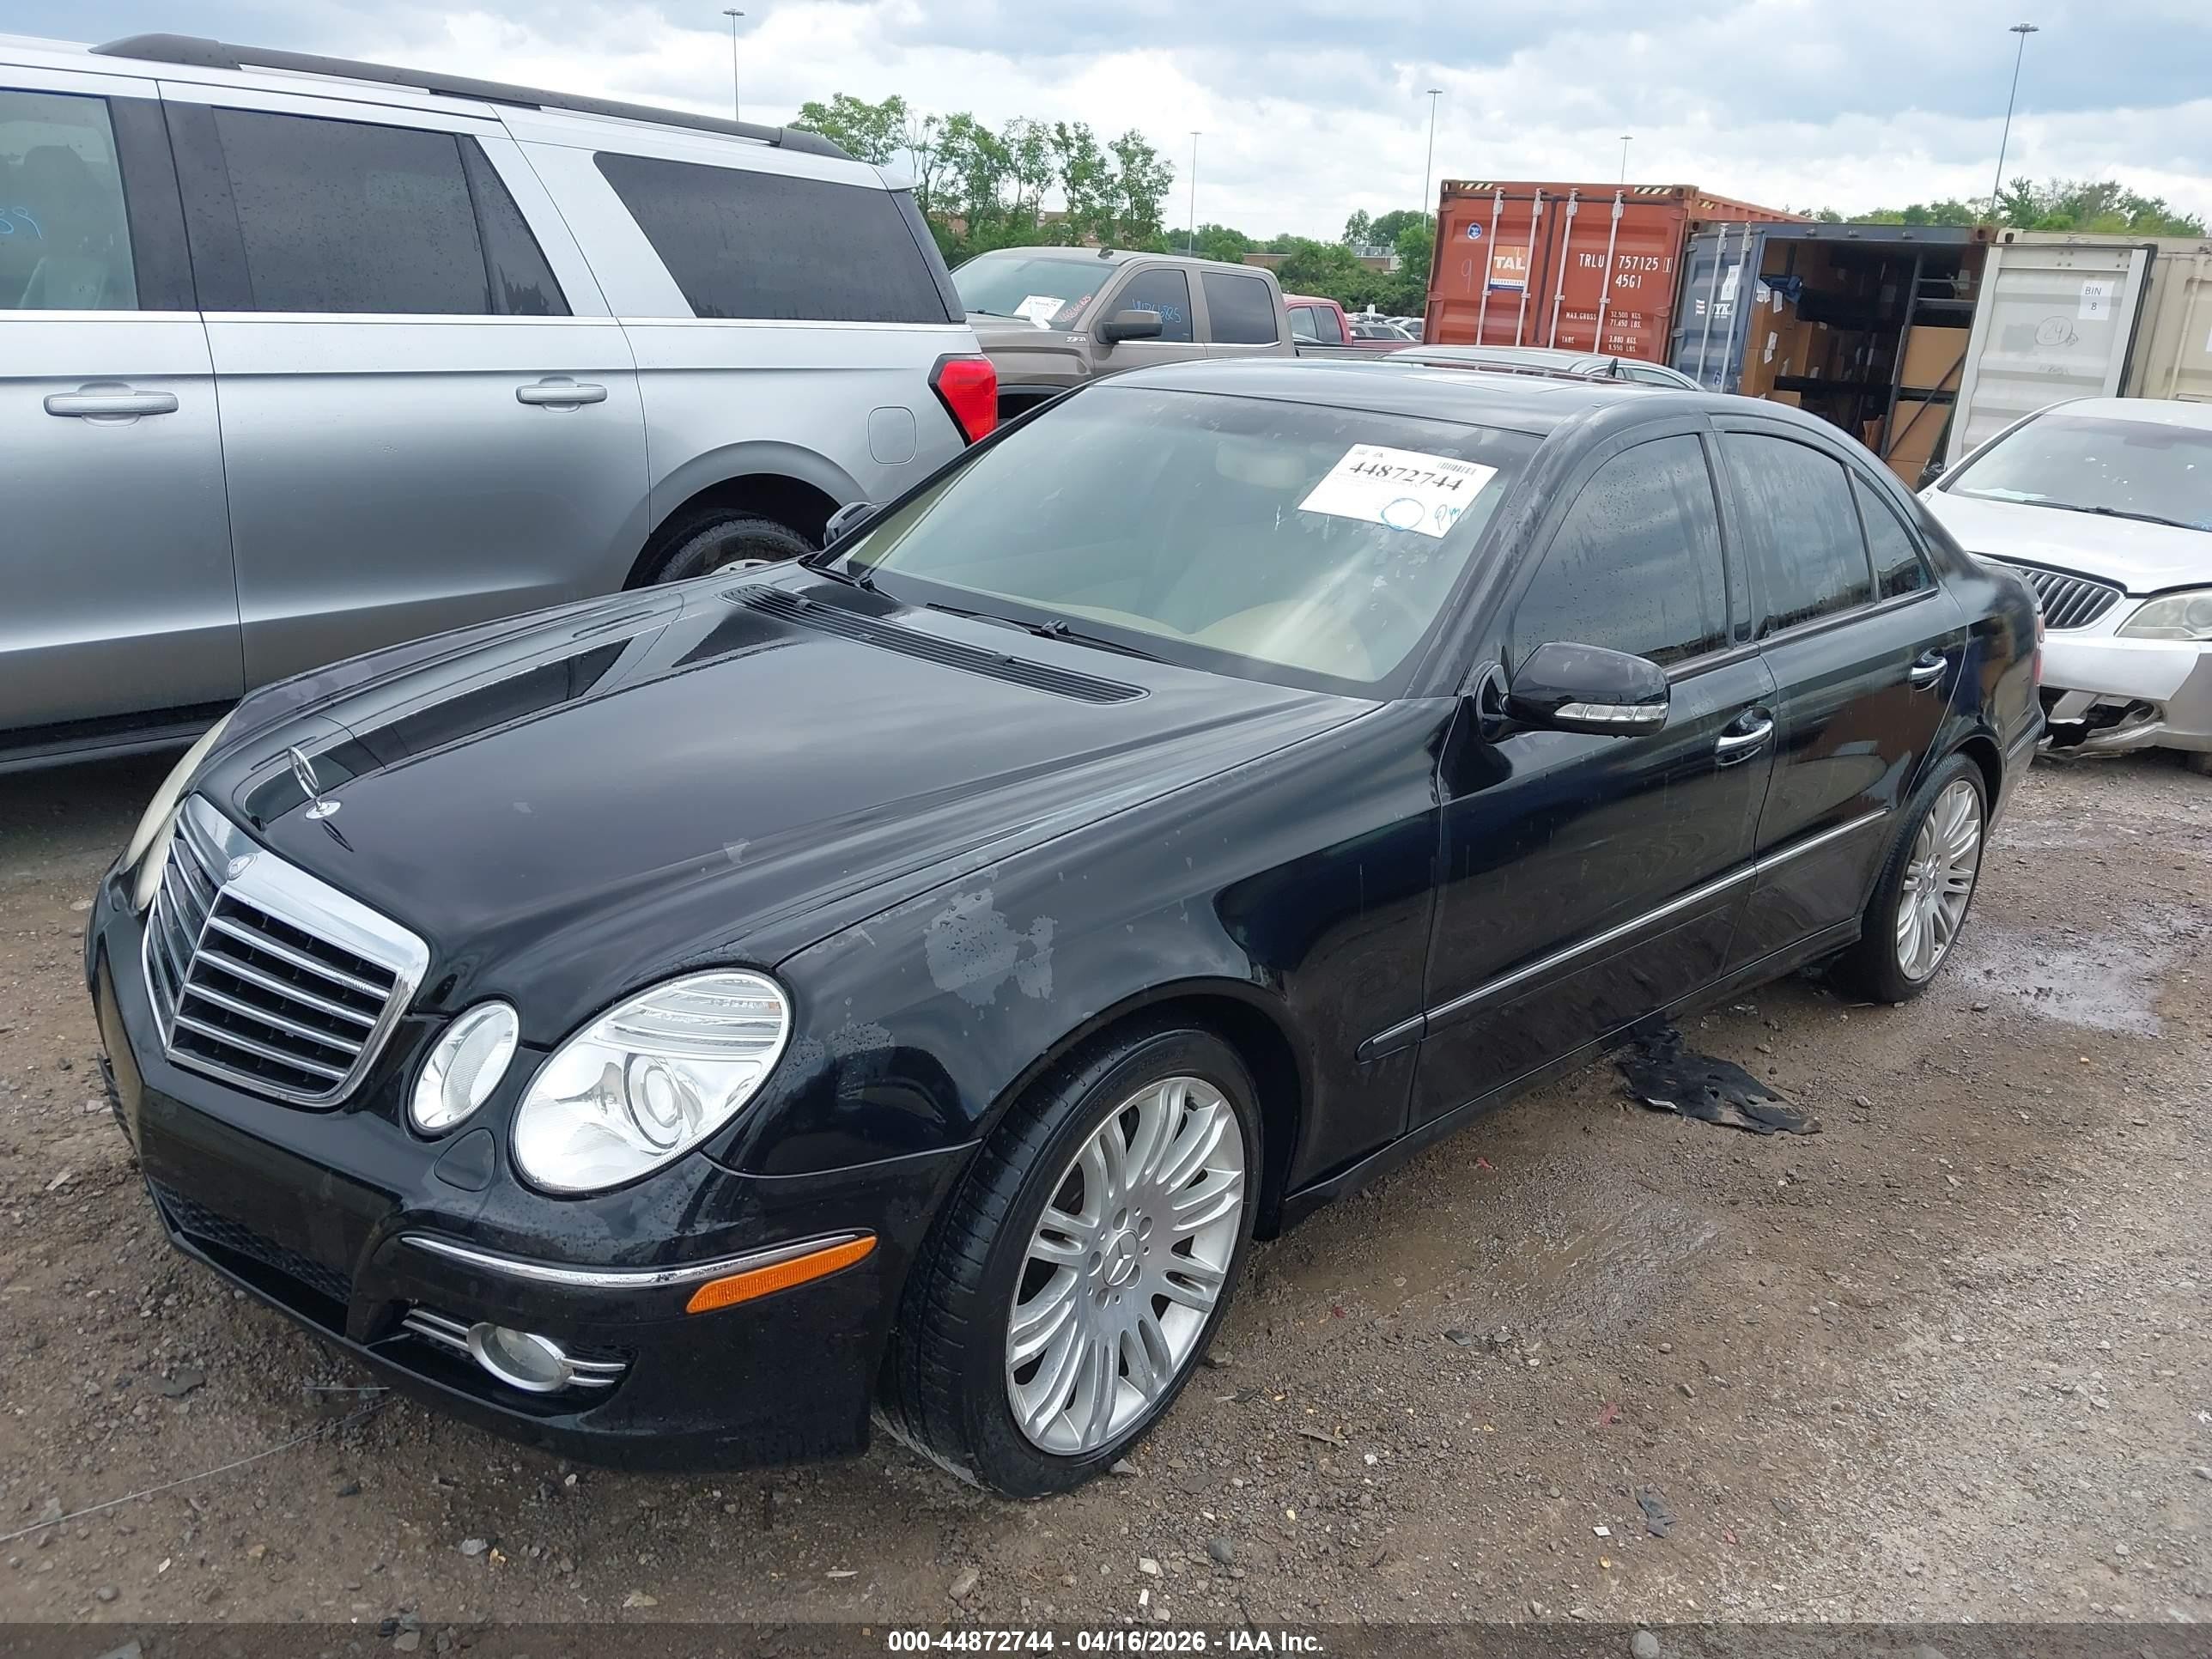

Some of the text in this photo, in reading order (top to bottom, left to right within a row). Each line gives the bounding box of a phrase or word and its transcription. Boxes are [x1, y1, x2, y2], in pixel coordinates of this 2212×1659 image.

[1494, 256, 1526, 270] TAL
[1579, 253, 1605, 268] TRLU
[1619, 255, 1659, 271] 757125
[1615, 274, 1642, 289] 45G1
[2085, 286, 2102, 295] BIN
[2091, 301, 2097, 311] 8
[1349, 461, 1464, 491] 44872744
